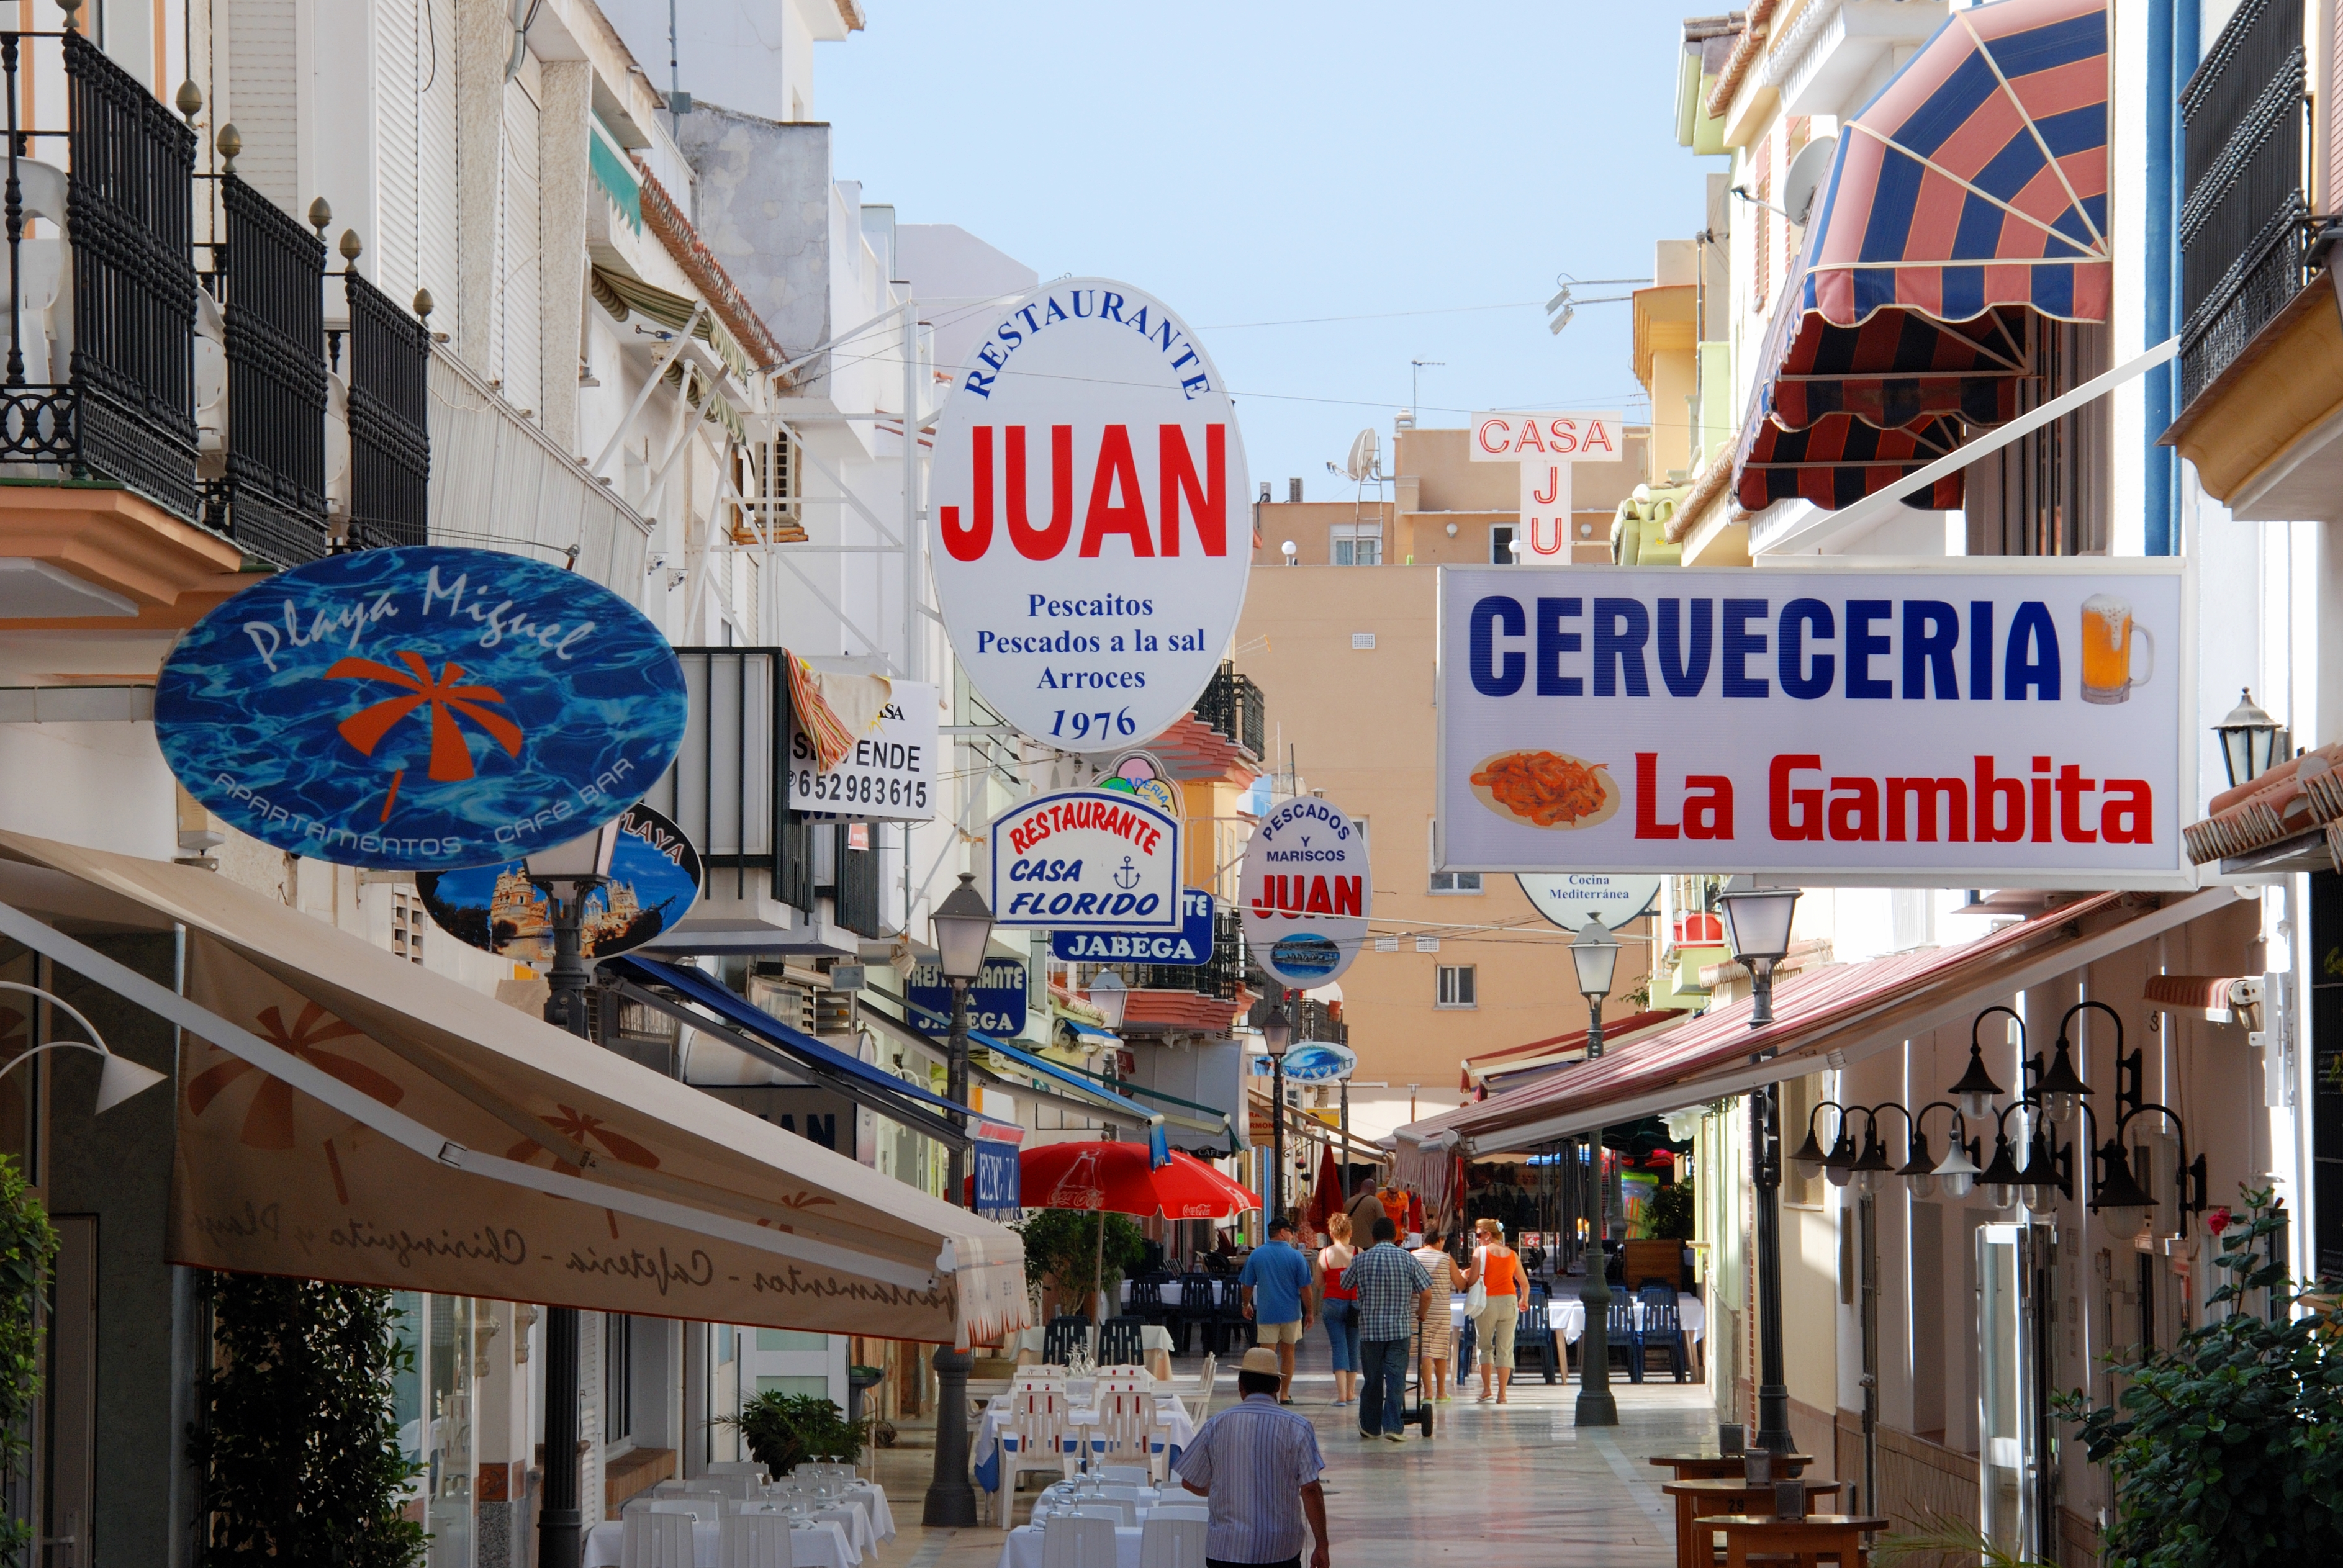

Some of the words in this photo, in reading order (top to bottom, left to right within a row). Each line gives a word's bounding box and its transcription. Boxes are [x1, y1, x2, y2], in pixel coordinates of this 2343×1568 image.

[964, 289, 1211, 401] RESTAURANTE
[1479, 419, 1612, 453] CASA
[940, 424, 1226, 562] JUAN
[243, 590, 399, 672] Playa
[423, 567, 595, 660] Miguel
[1027, 593, 1153, 618] Pescaitos
[977, 630, 1100, 654] Pescados
[1110, 635, 1125, 652] a
[1134, 629, 1158, 652] la
[1168, 628, 1206, 652] sal
[1469, 595, 2061, 702] CERVECERIA
[1037, 667, 1146, 689] Arroces
[1049, 706, 1136, 741] 1976
[793, 732, 816, 760] S
[843, 739, 921, 772] ENDE
[578, 757, 635, 805] BAR
[798, 770, 926, 808] 652983615
[1635, 752, 1735, 840] La
[1769, 754, 2154, 844] Gambita
[1009, 801, 1162, 856] RESTAURANTE
[1262, 803, 1350, 842] PESCADOS
[1266, 850, 1346, 862] MARISCOS
[1301, 836, 1311, 847] Y
[1009, 859, 1083, 882] CASA
[1569, 874, 1609, 885] Cocina
[1009, 892, 1160, 916] FLORIDO
[1252, 875, 1362, 919] JUAN
[1550, 889, 1629, 899] Mediterránea
[1068, 935, 1196, 959] JABEGA
[911, 965, 1023, 989] RESANTE
[1728, 1498, 1745, 1513] 29
